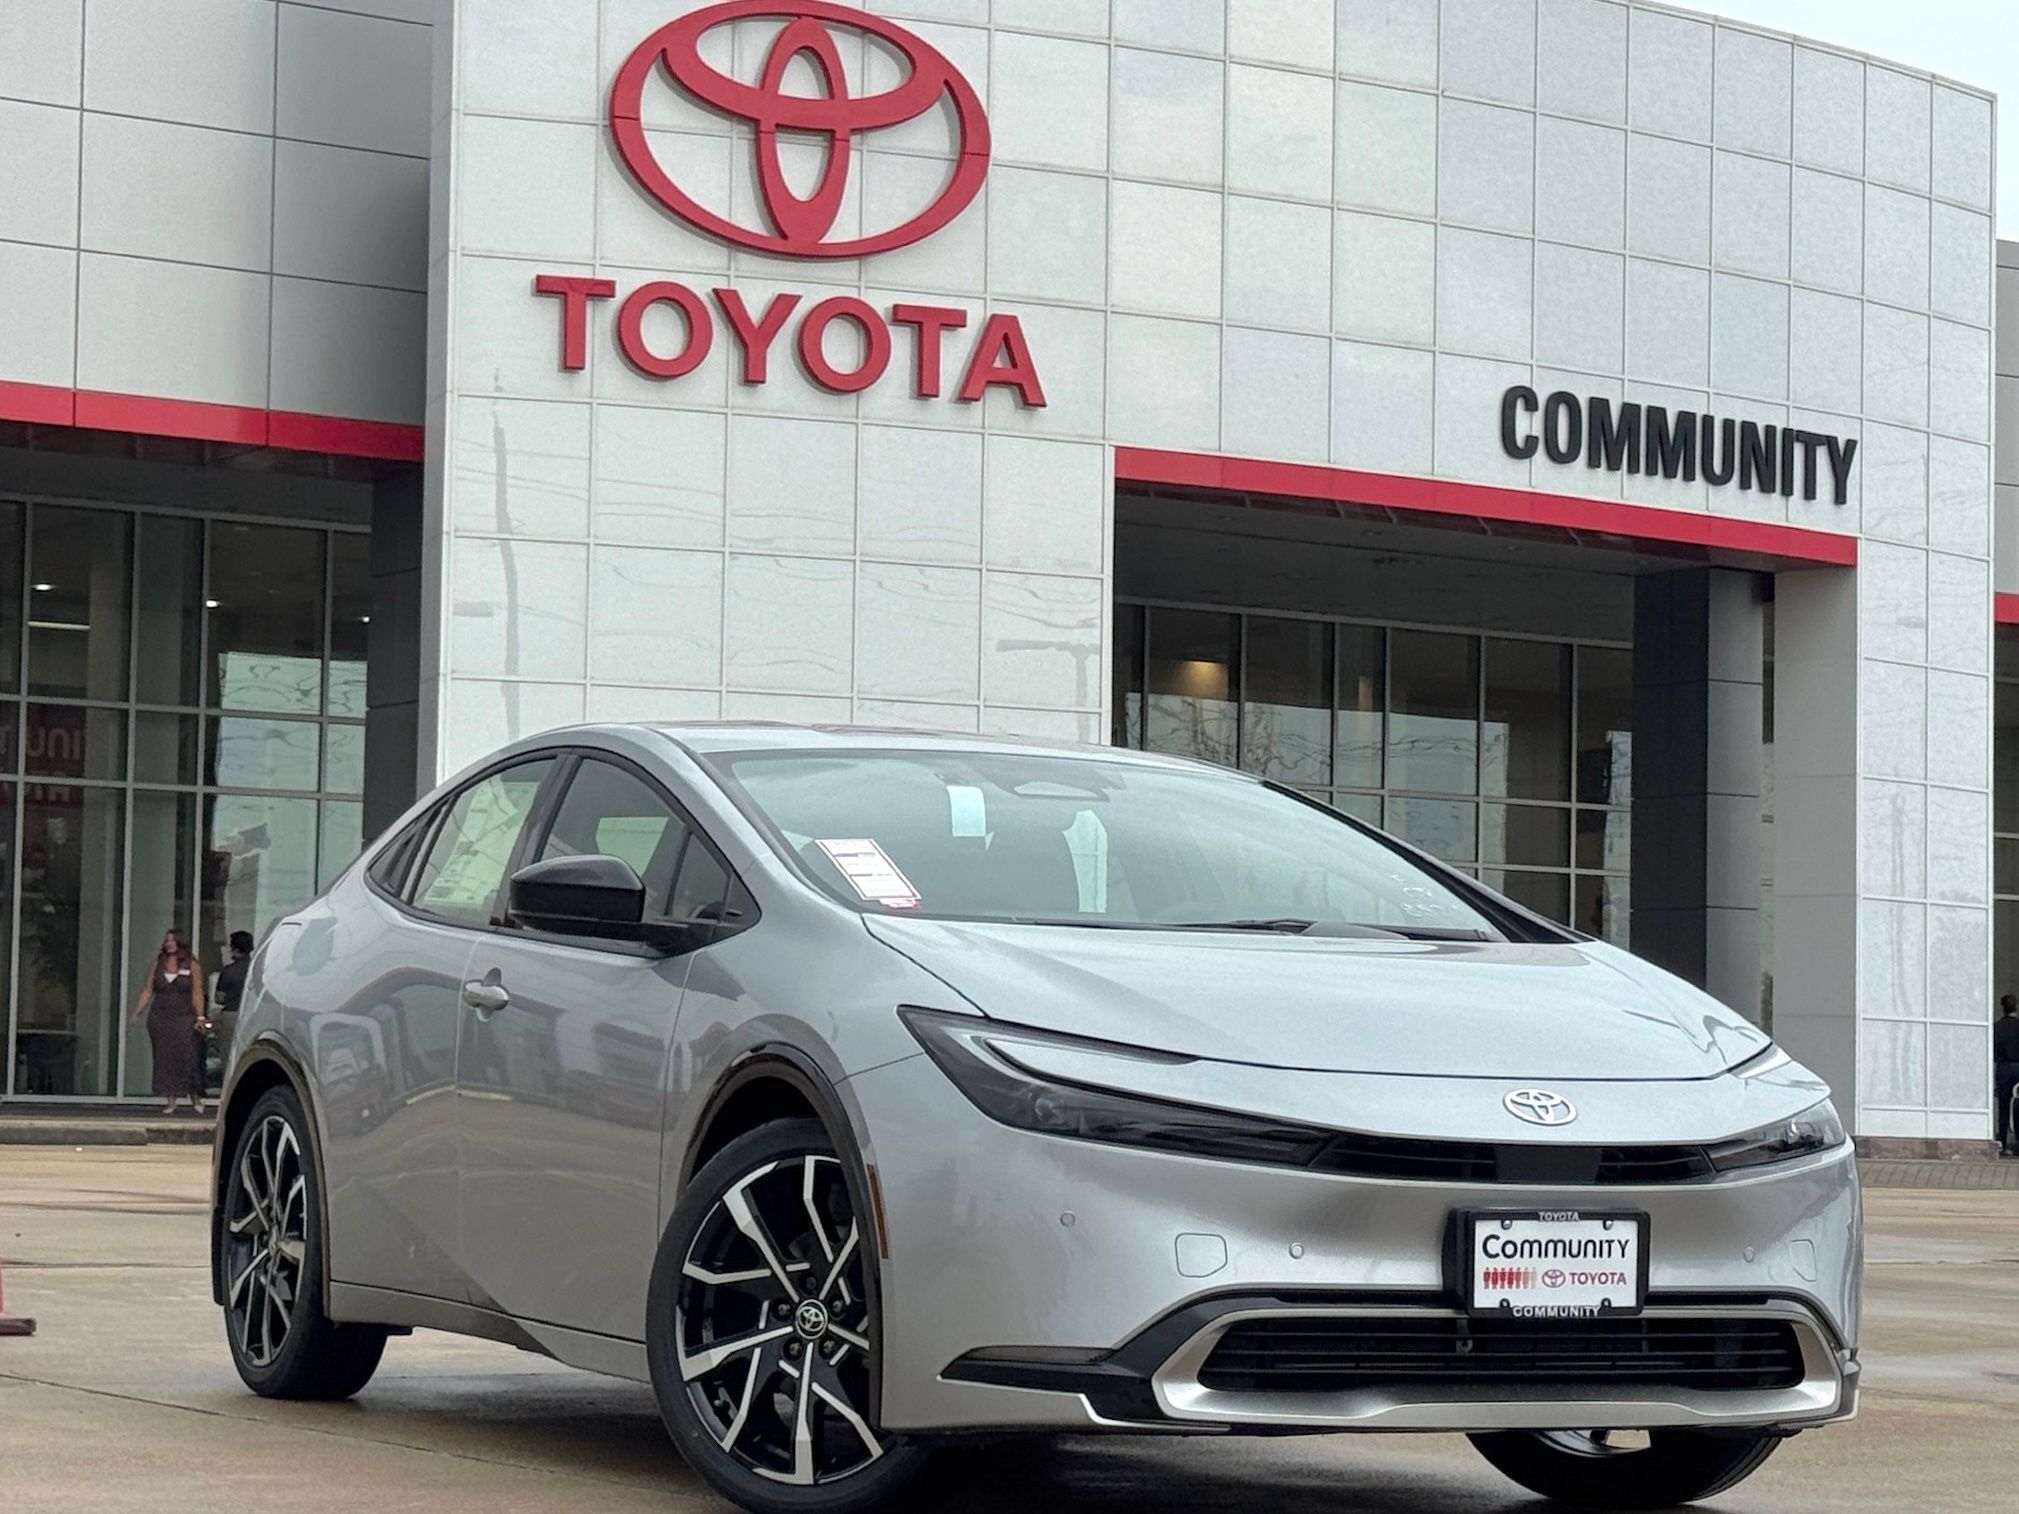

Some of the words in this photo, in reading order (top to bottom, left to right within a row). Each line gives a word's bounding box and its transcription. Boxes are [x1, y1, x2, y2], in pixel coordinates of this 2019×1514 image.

[534, 274, 1047, 409] TOYOTA
[1501, 385, 1859, 505] COMMUNITY
[1538, 1211, 1580, 1222] TOYOTA
[1569, 1271, 1627, 1285] TOYOTA
[1512, 1304, 1601, 1318] COMMUNITY
